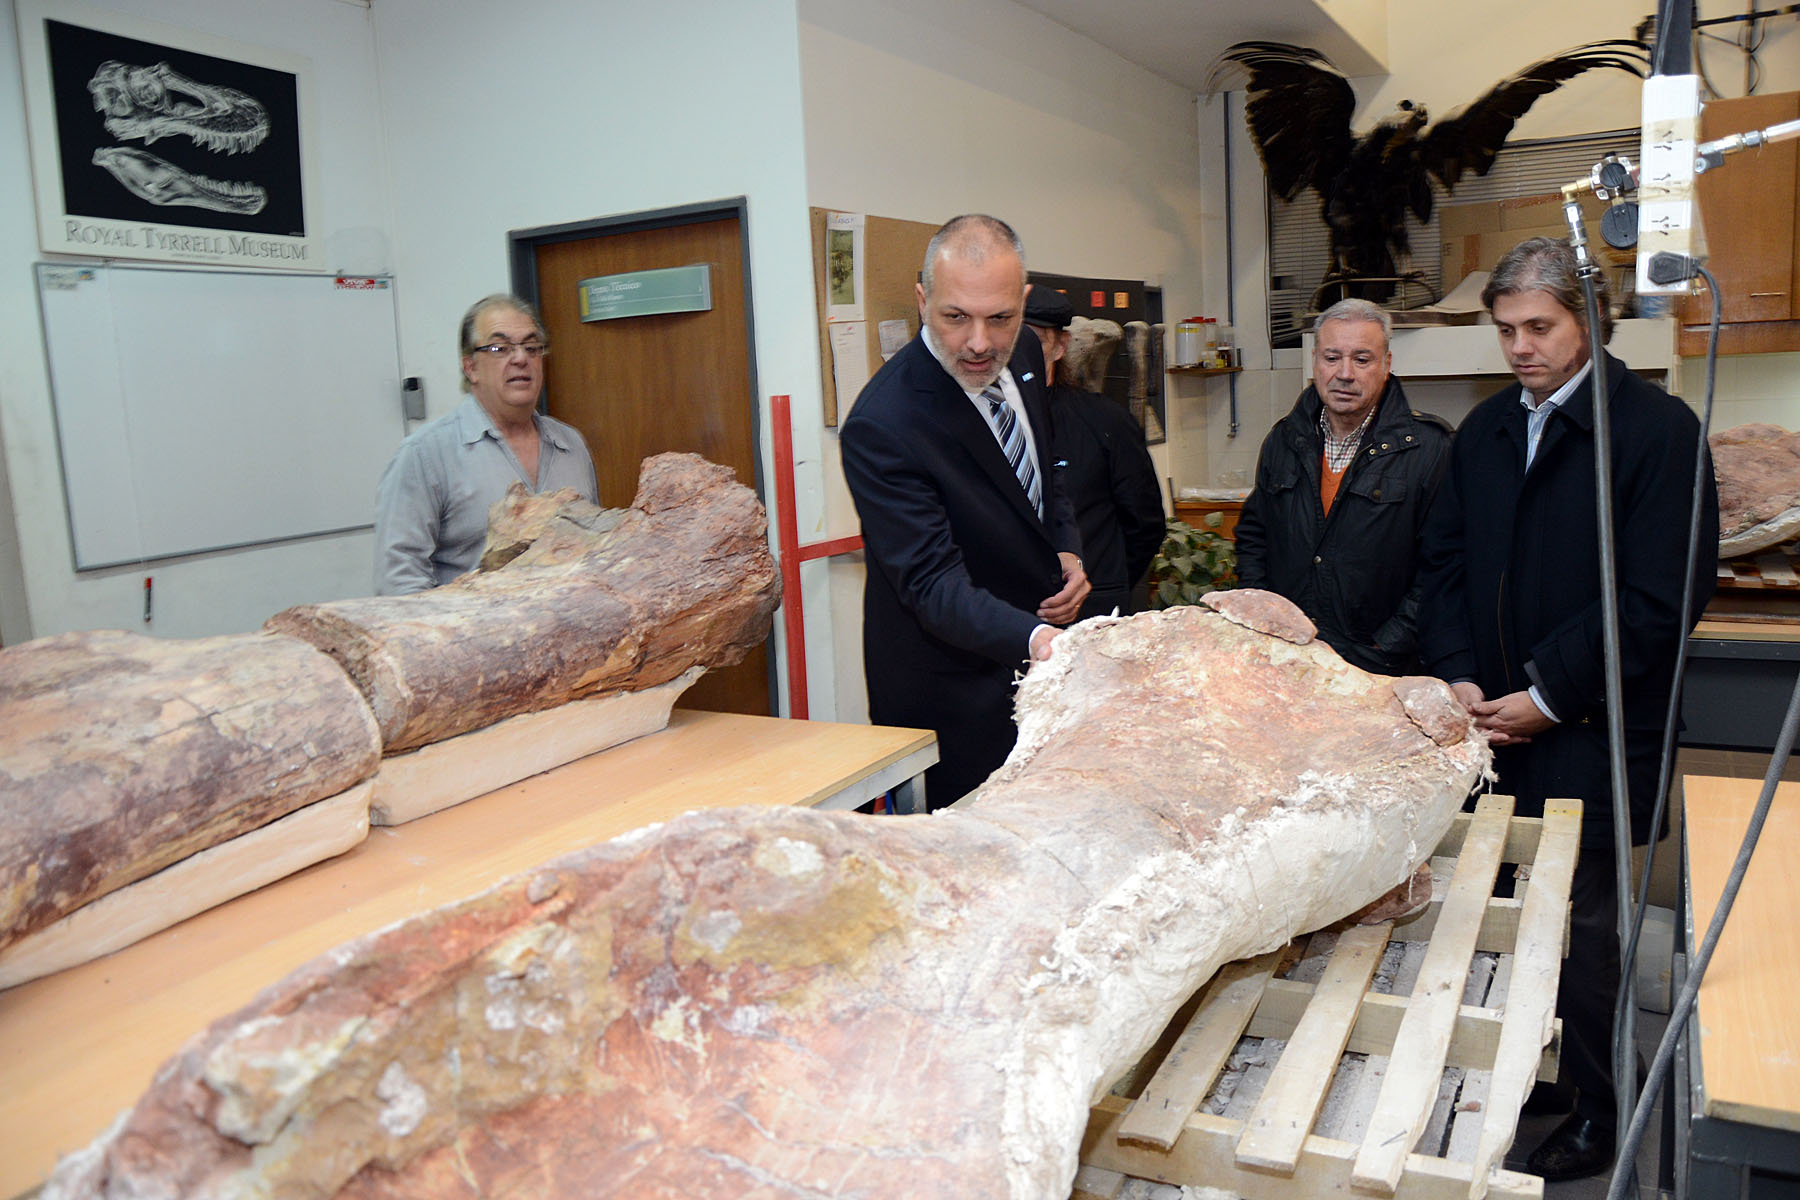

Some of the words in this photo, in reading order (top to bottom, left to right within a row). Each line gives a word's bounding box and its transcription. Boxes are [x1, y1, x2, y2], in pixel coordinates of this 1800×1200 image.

[65, 219, 139, 248] ROYAL
[140, 227, 225, 254] TYRRELL
[228, 235, 309, 260] MUSEUM
